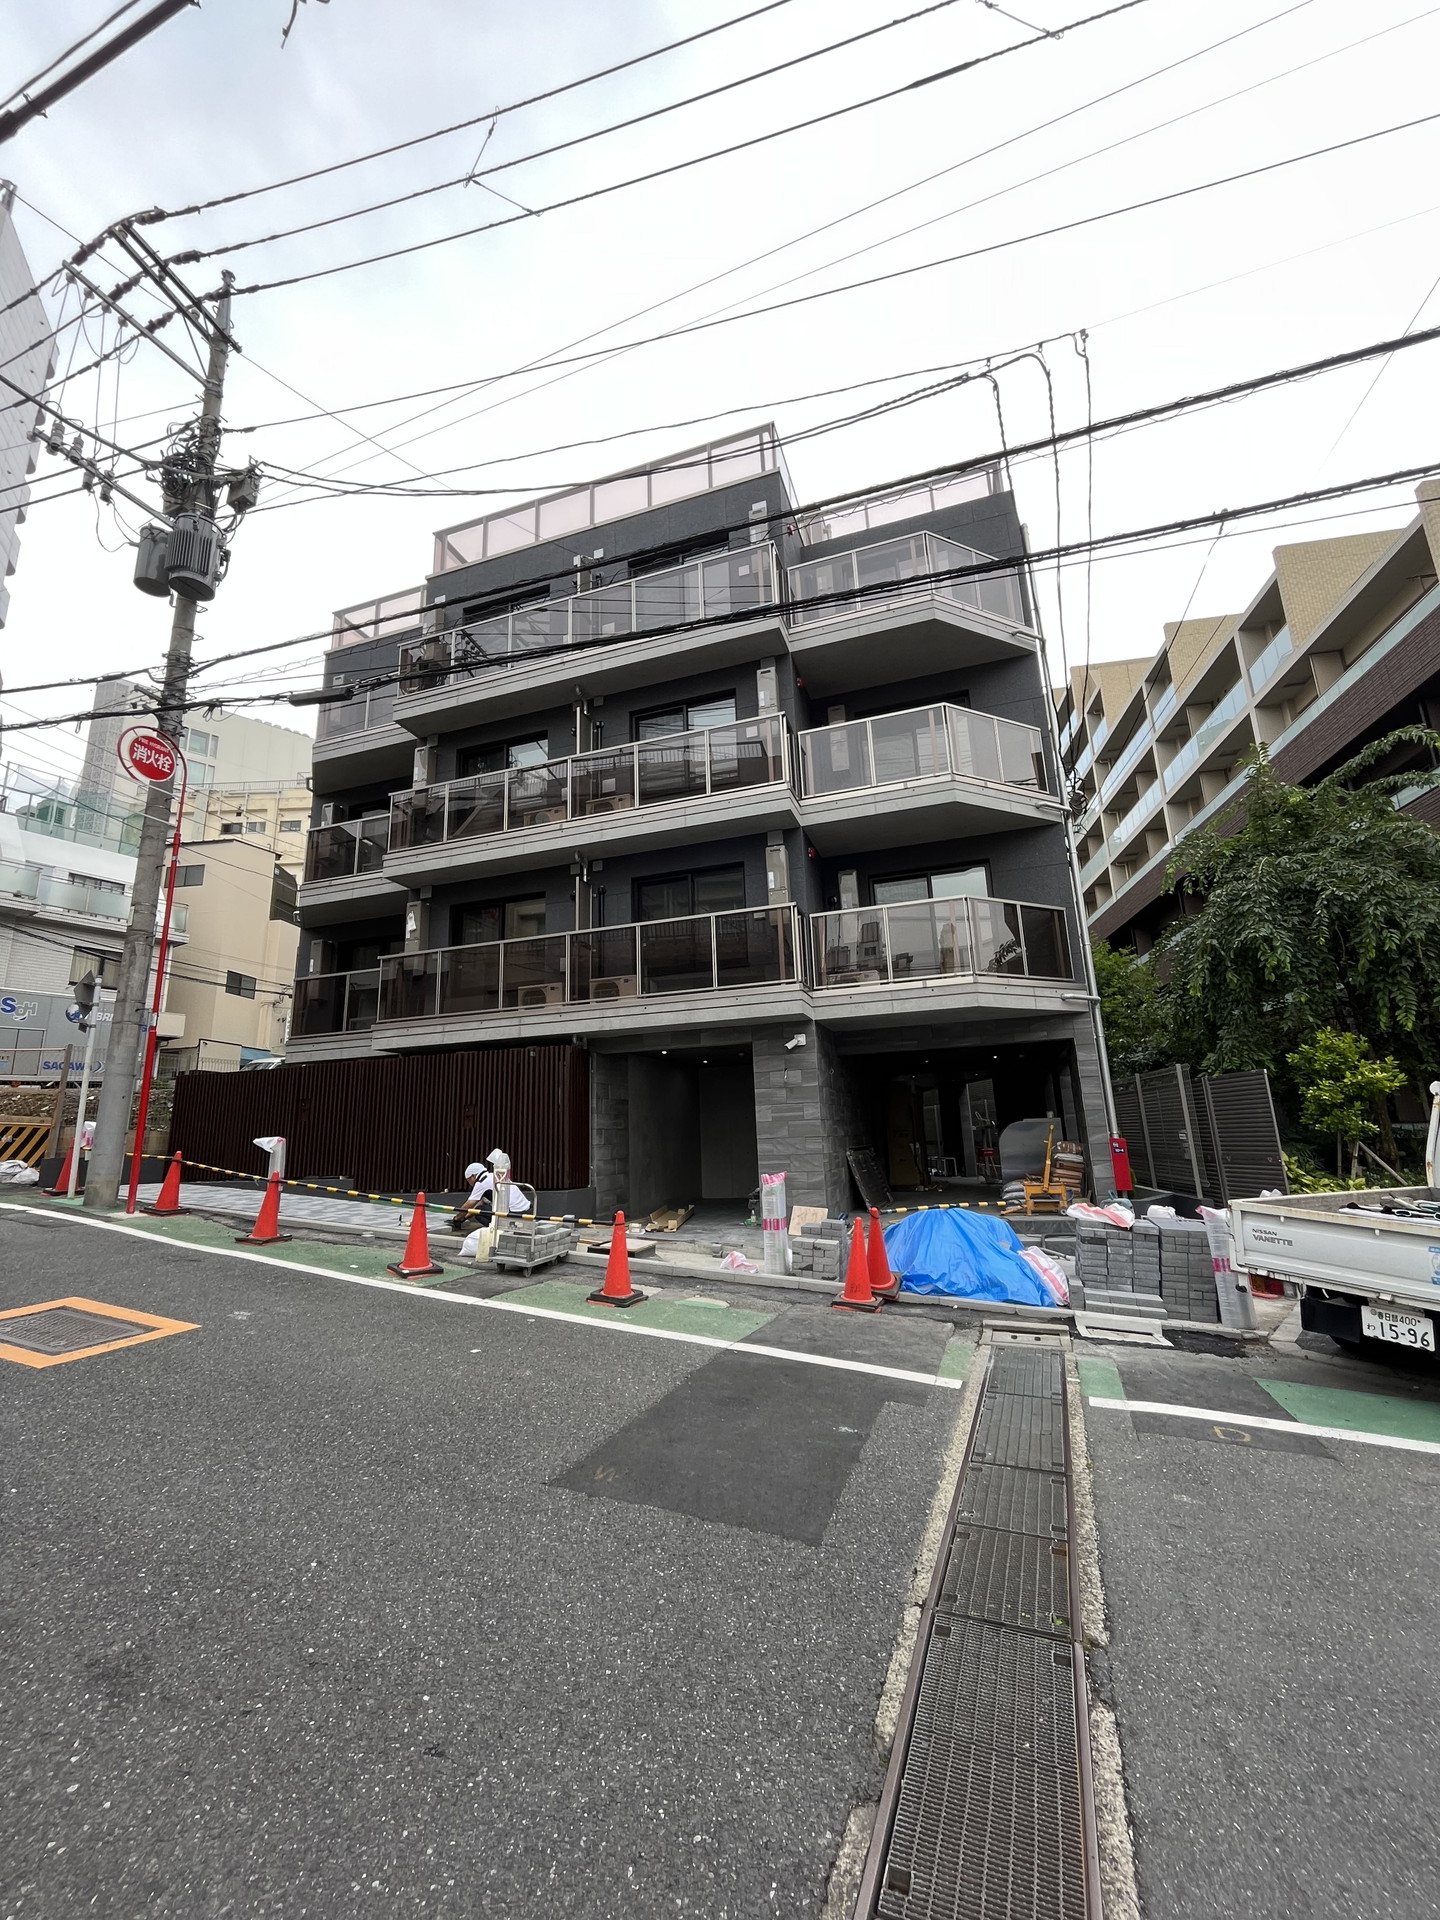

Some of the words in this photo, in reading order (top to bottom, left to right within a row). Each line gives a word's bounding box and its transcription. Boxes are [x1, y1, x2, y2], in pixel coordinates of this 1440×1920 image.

[132, 742, 173, 773] 消火栓
[1252, 1228, 1278, 1236] NISSAN
[1252, 1234, 1294, 1246] VANETTE
[1380, 1321, 1430, 1347] 15-96
